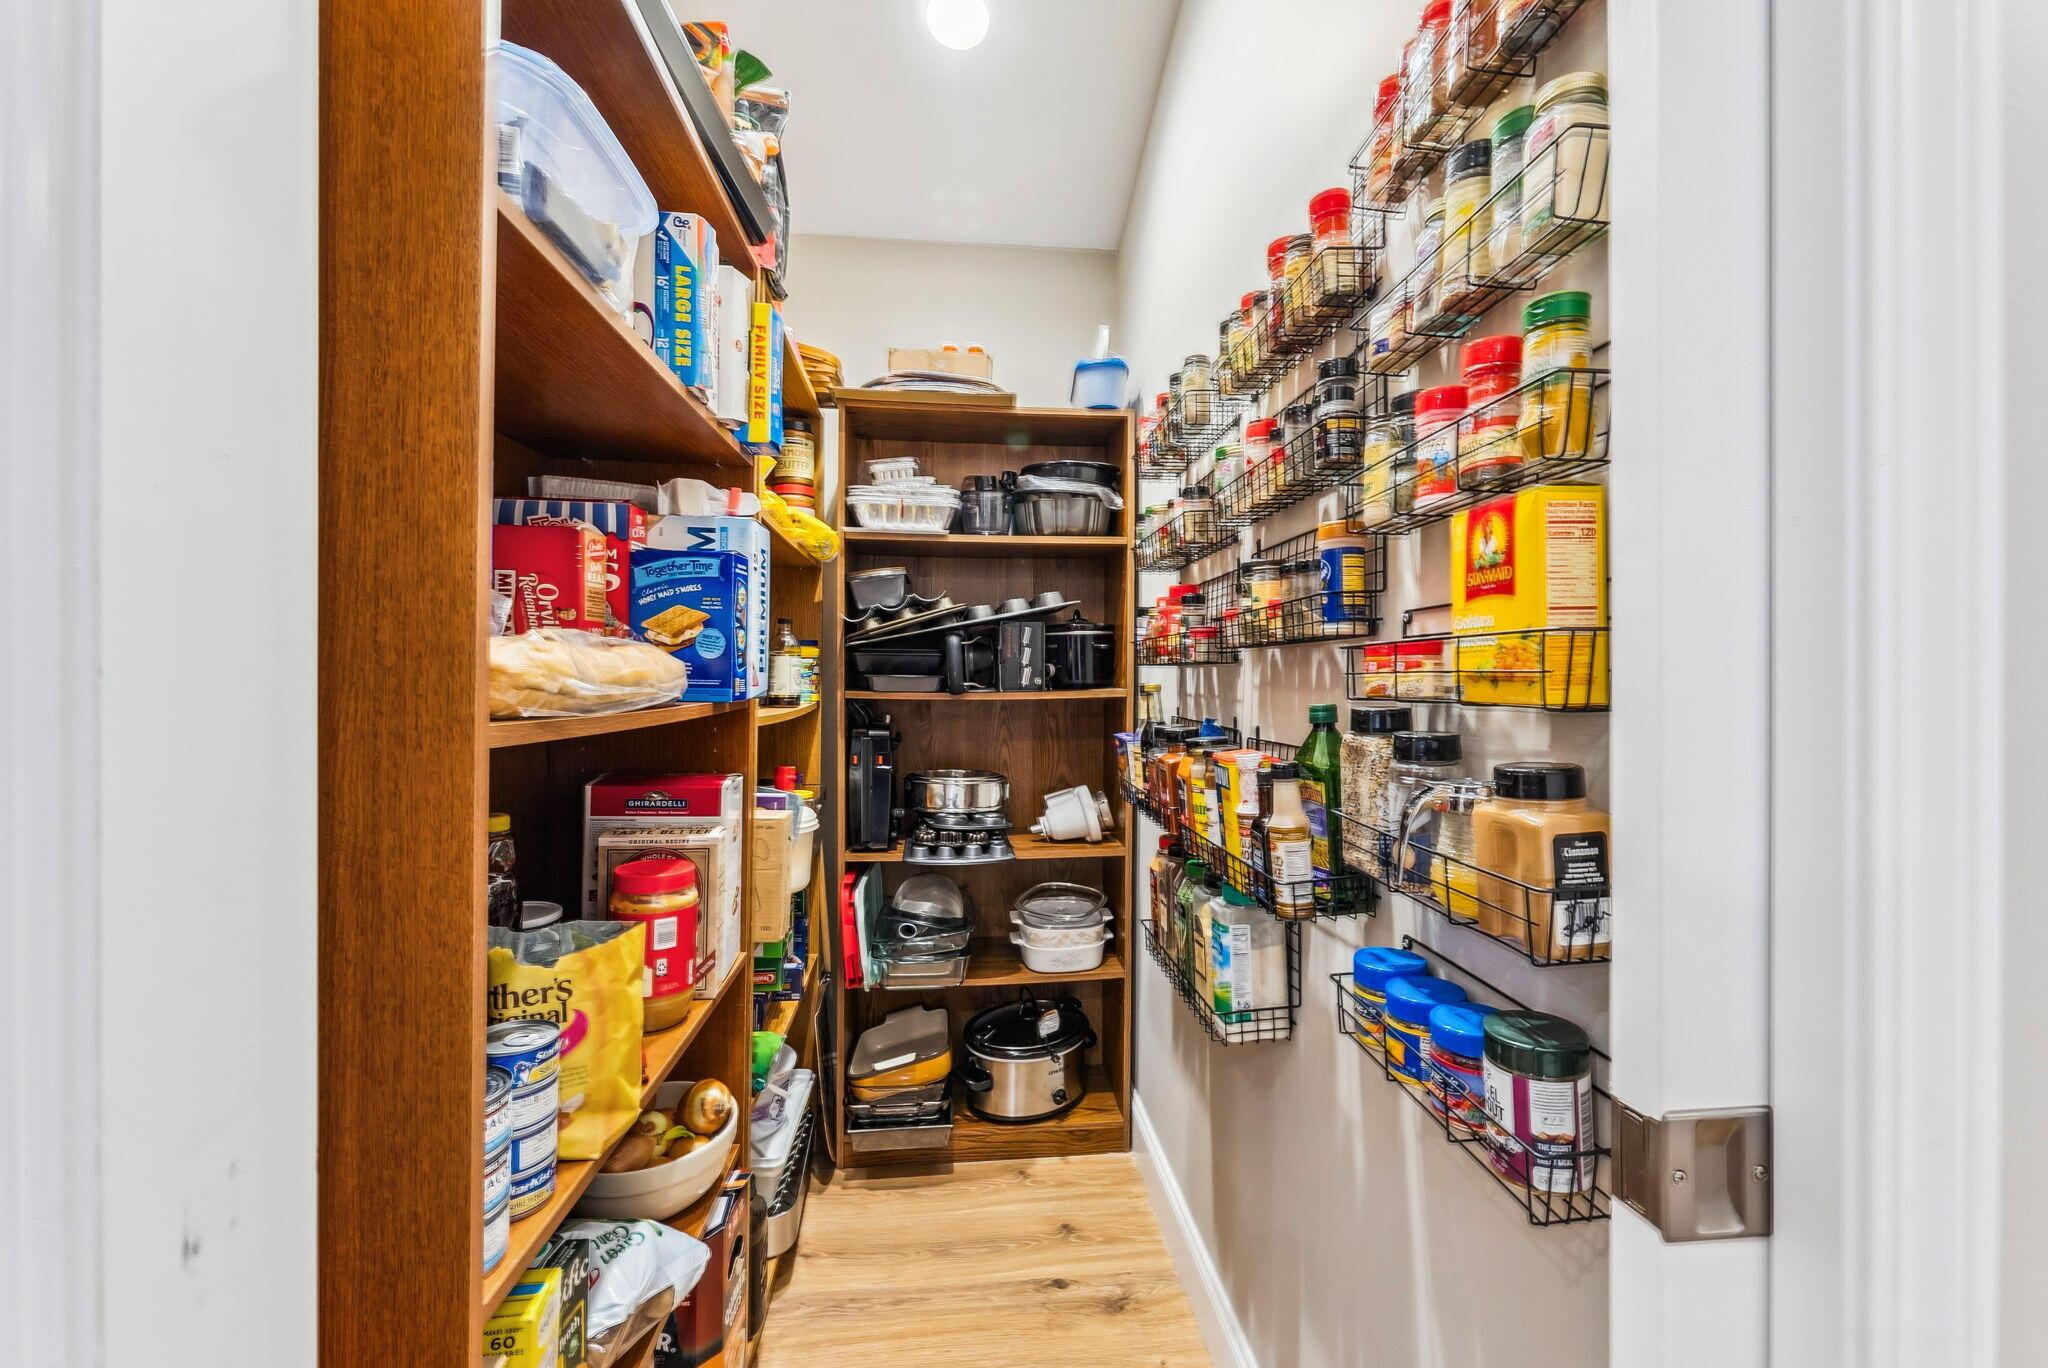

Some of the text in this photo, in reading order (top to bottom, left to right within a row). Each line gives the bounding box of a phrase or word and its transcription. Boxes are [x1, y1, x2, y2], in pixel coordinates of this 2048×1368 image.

[674, 265, 692, 366] LARGE SIZE
[754, 324, 767, 420] FAMILY SIZE
[642, 560, 690, 578] Together
[690, 560, 713, 571] Time
[590, 1226, 630, 1252] Giant
[600, 1232, 645, 1265] Green
[490, 1336, 516, 1351] 60
